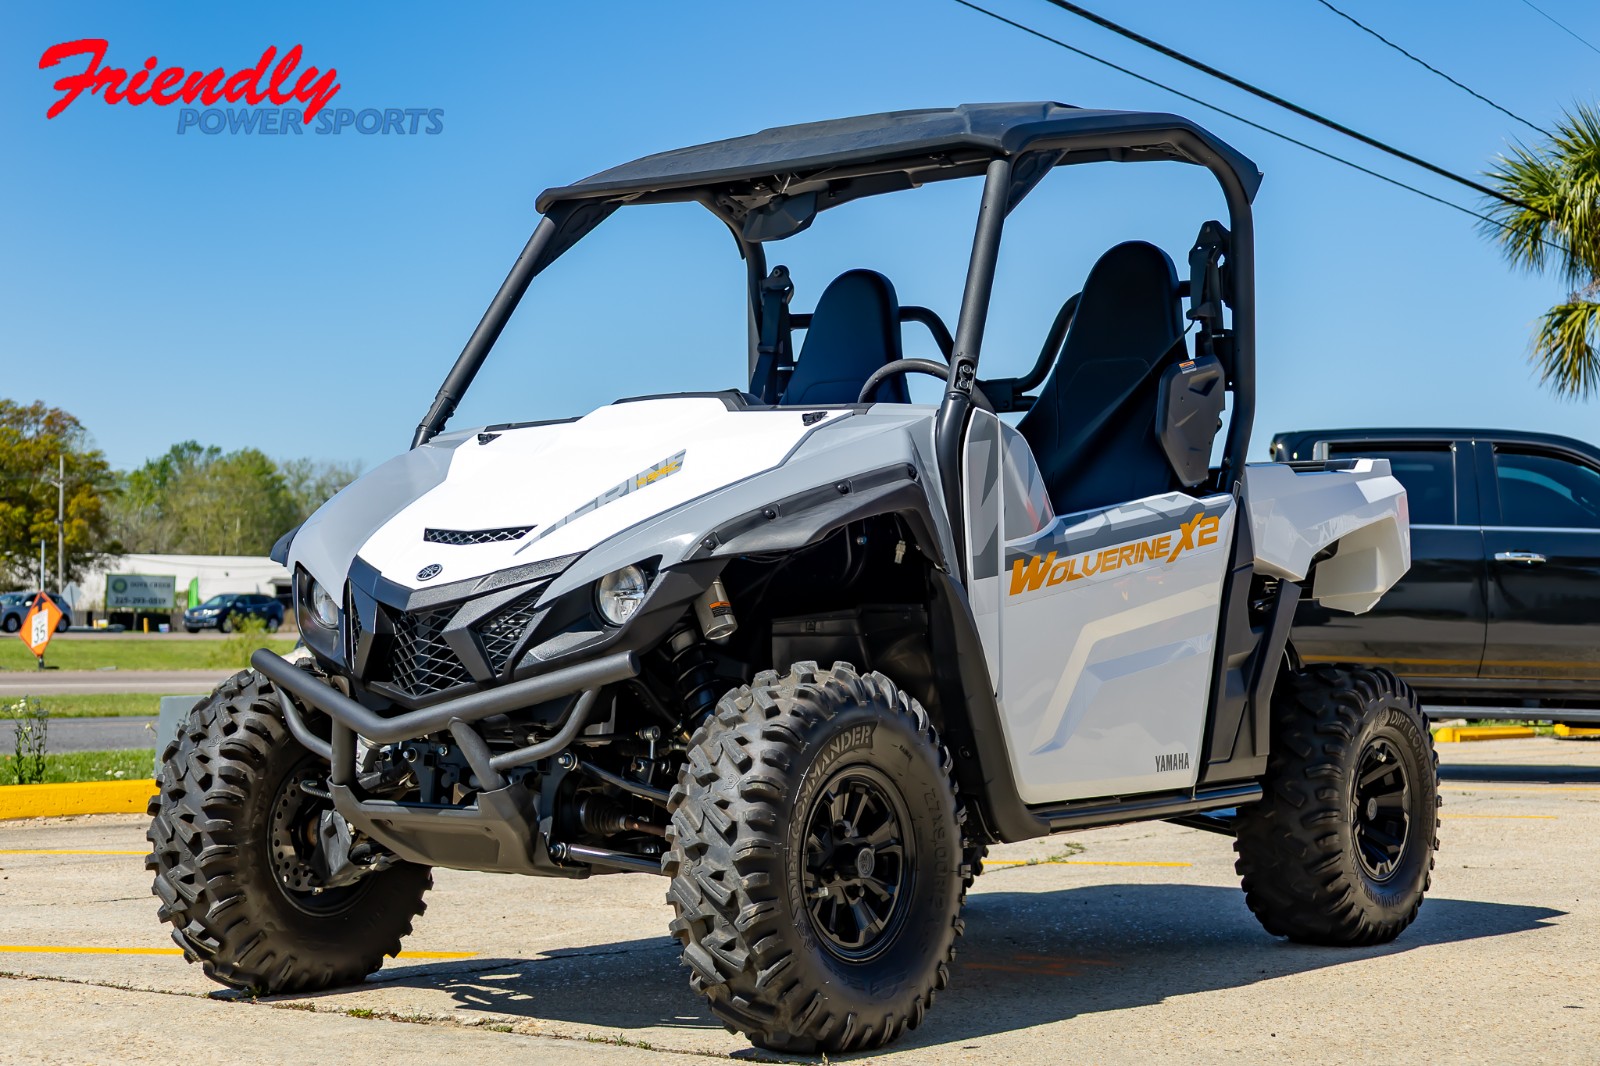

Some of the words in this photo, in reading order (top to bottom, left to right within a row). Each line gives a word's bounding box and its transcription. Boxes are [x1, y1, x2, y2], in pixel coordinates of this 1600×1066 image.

[1008, 535, 1172, 597] WOLVERINE
[1165, 512, 1220, 564] X2
[33, 623, 46, 644] 35
[1389, 711, 1410, 733] DIRT
[1154, 752, 1190, 773] YAMAHA
[791, 725, 872, 841] COMMANDER
